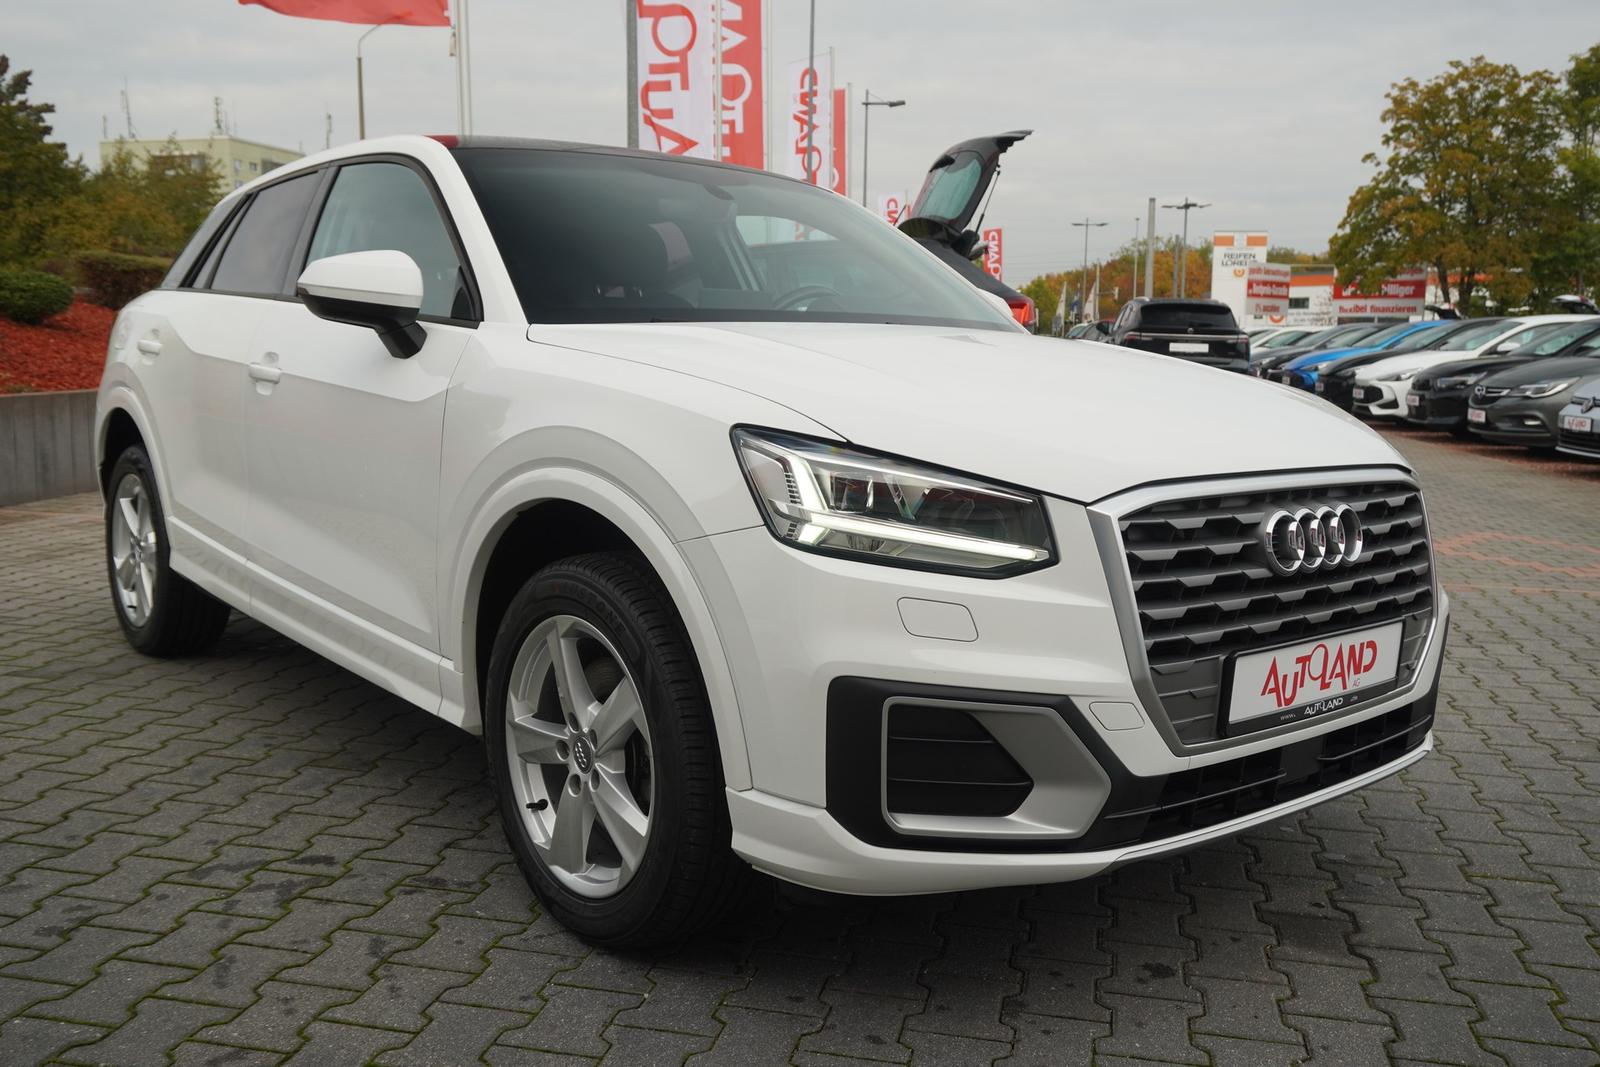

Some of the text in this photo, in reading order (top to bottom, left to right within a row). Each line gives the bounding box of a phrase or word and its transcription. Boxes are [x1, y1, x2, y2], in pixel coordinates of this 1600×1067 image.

[1370, 304, 1417, 314] finanzieren
[1260, 639, 1378, 708] AUTOLAND
[1303, 697, 1344, 715] AUTOLAND
